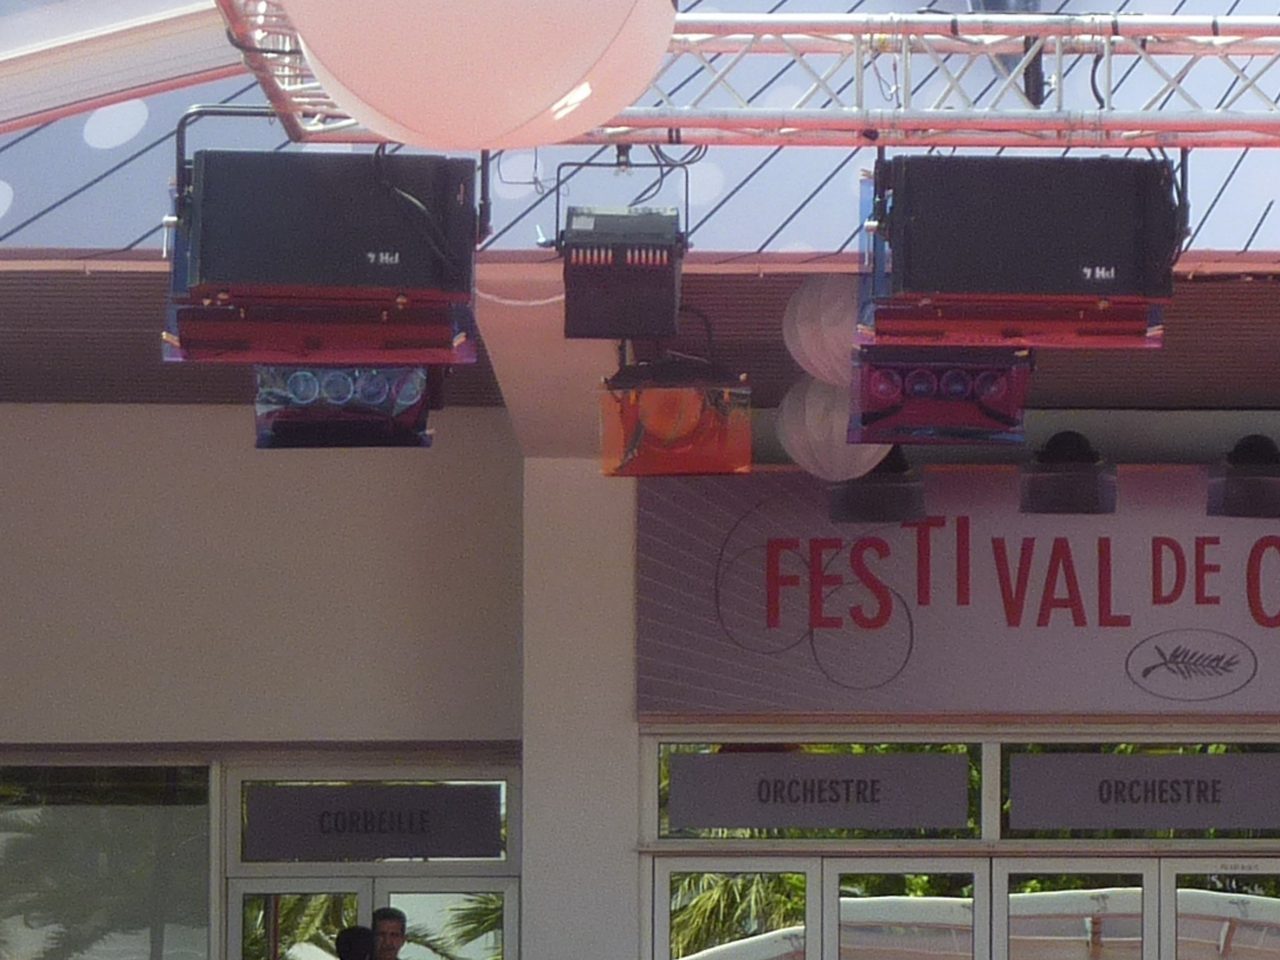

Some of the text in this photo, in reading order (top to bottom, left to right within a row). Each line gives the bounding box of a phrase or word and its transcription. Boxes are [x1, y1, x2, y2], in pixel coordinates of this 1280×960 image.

[764, 516, 1131, 629] FESTIVAL
[1151, 536, 1221, 605] DE
[757, 779, 881, 804] ORCHESTRE
[1098, 779, 1222, 804] ORCHESTRE
[320, 810, 430, 833] CORBEILLE
